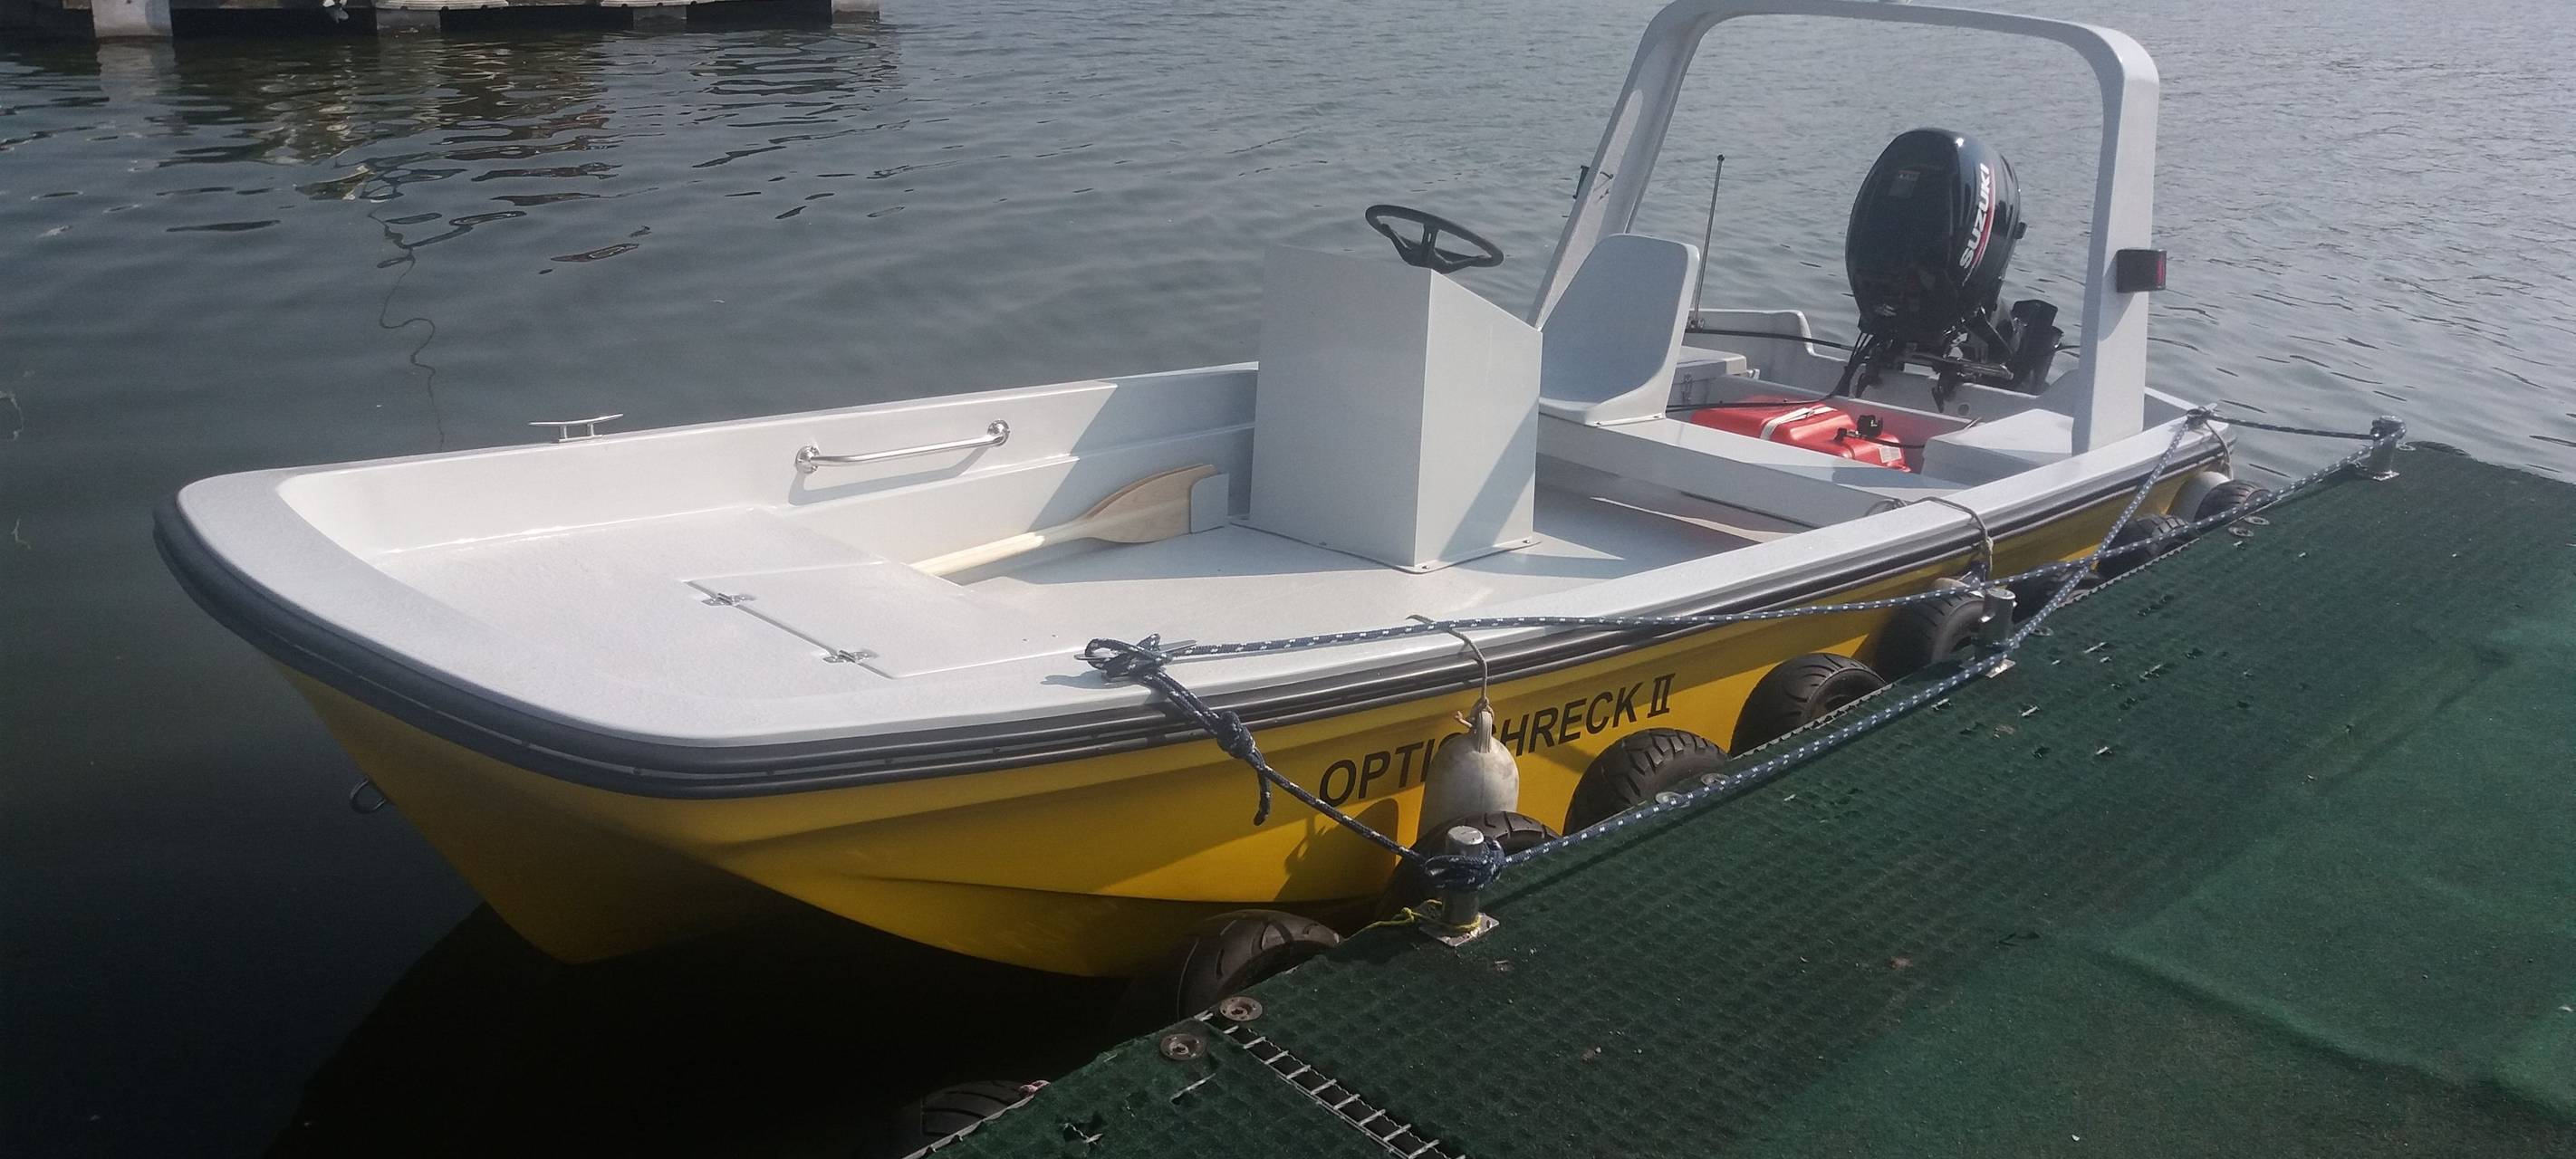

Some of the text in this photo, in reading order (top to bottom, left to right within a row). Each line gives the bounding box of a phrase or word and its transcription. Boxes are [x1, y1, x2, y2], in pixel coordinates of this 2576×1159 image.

[1959, 163, 1990, 269] SUZUKI
[1319, 673, 1676, 807] OPTIHRECK II
